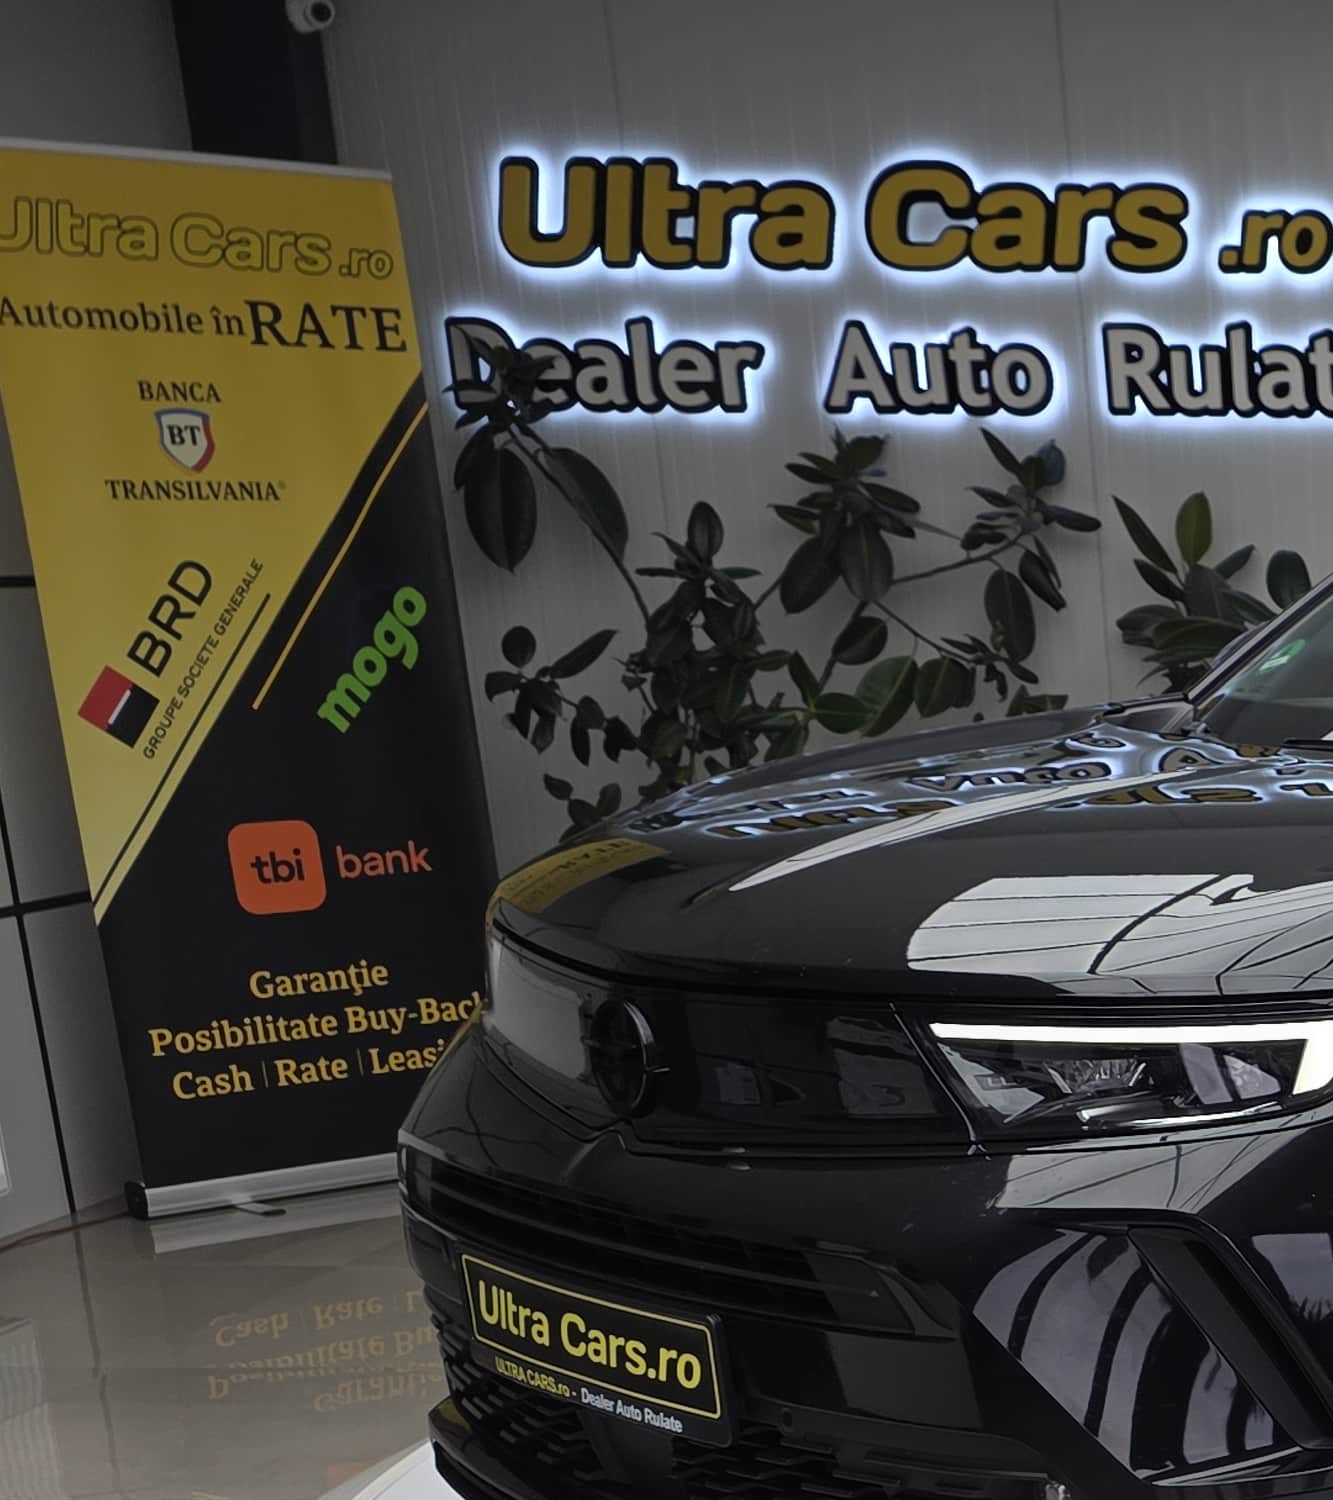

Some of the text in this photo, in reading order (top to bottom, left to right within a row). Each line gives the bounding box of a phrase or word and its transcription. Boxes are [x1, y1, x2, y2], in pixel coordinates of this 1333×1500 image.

[169, 211, 332, 276] Cars
[338, 247, 394, 280] .ro
[499, 155, 836, 271] Ultra
[865, 159, 1189, 274] Cars
[0, 296, 408, 352] Automobile în RATE
[137, 379, 222, 403] BANCA
[444, 316, 765, 413] Dealer
[823, 319, 1054, 417] Auto
[167, 423, 201, 446] BT
[104, 478, 281, 502] TRANSILVANIA
[126, 559, 213, 678] BRD
[143, 557, 264, 760] GROUPE SOCIETE GENERALE
[316, 586, 427, 734] mogo
[250, 839, 433, 884] tbi bank
[148, 1014, 339, 1058] Posibilitate
[171, 1065, 255, 1101] Cash
[273, 1055, 349, 1088] Rate
[367, 1037, 446, 1075] Leas
[478, 1279, 551, 1347] Ultra
[559, 1311, 702, 1390] Cars.ro
[580, 1386, 615, 1414] Dealer
[615, 1398, 643, 1423] Auto
[643, 1406, 684, 1434] Rulate
